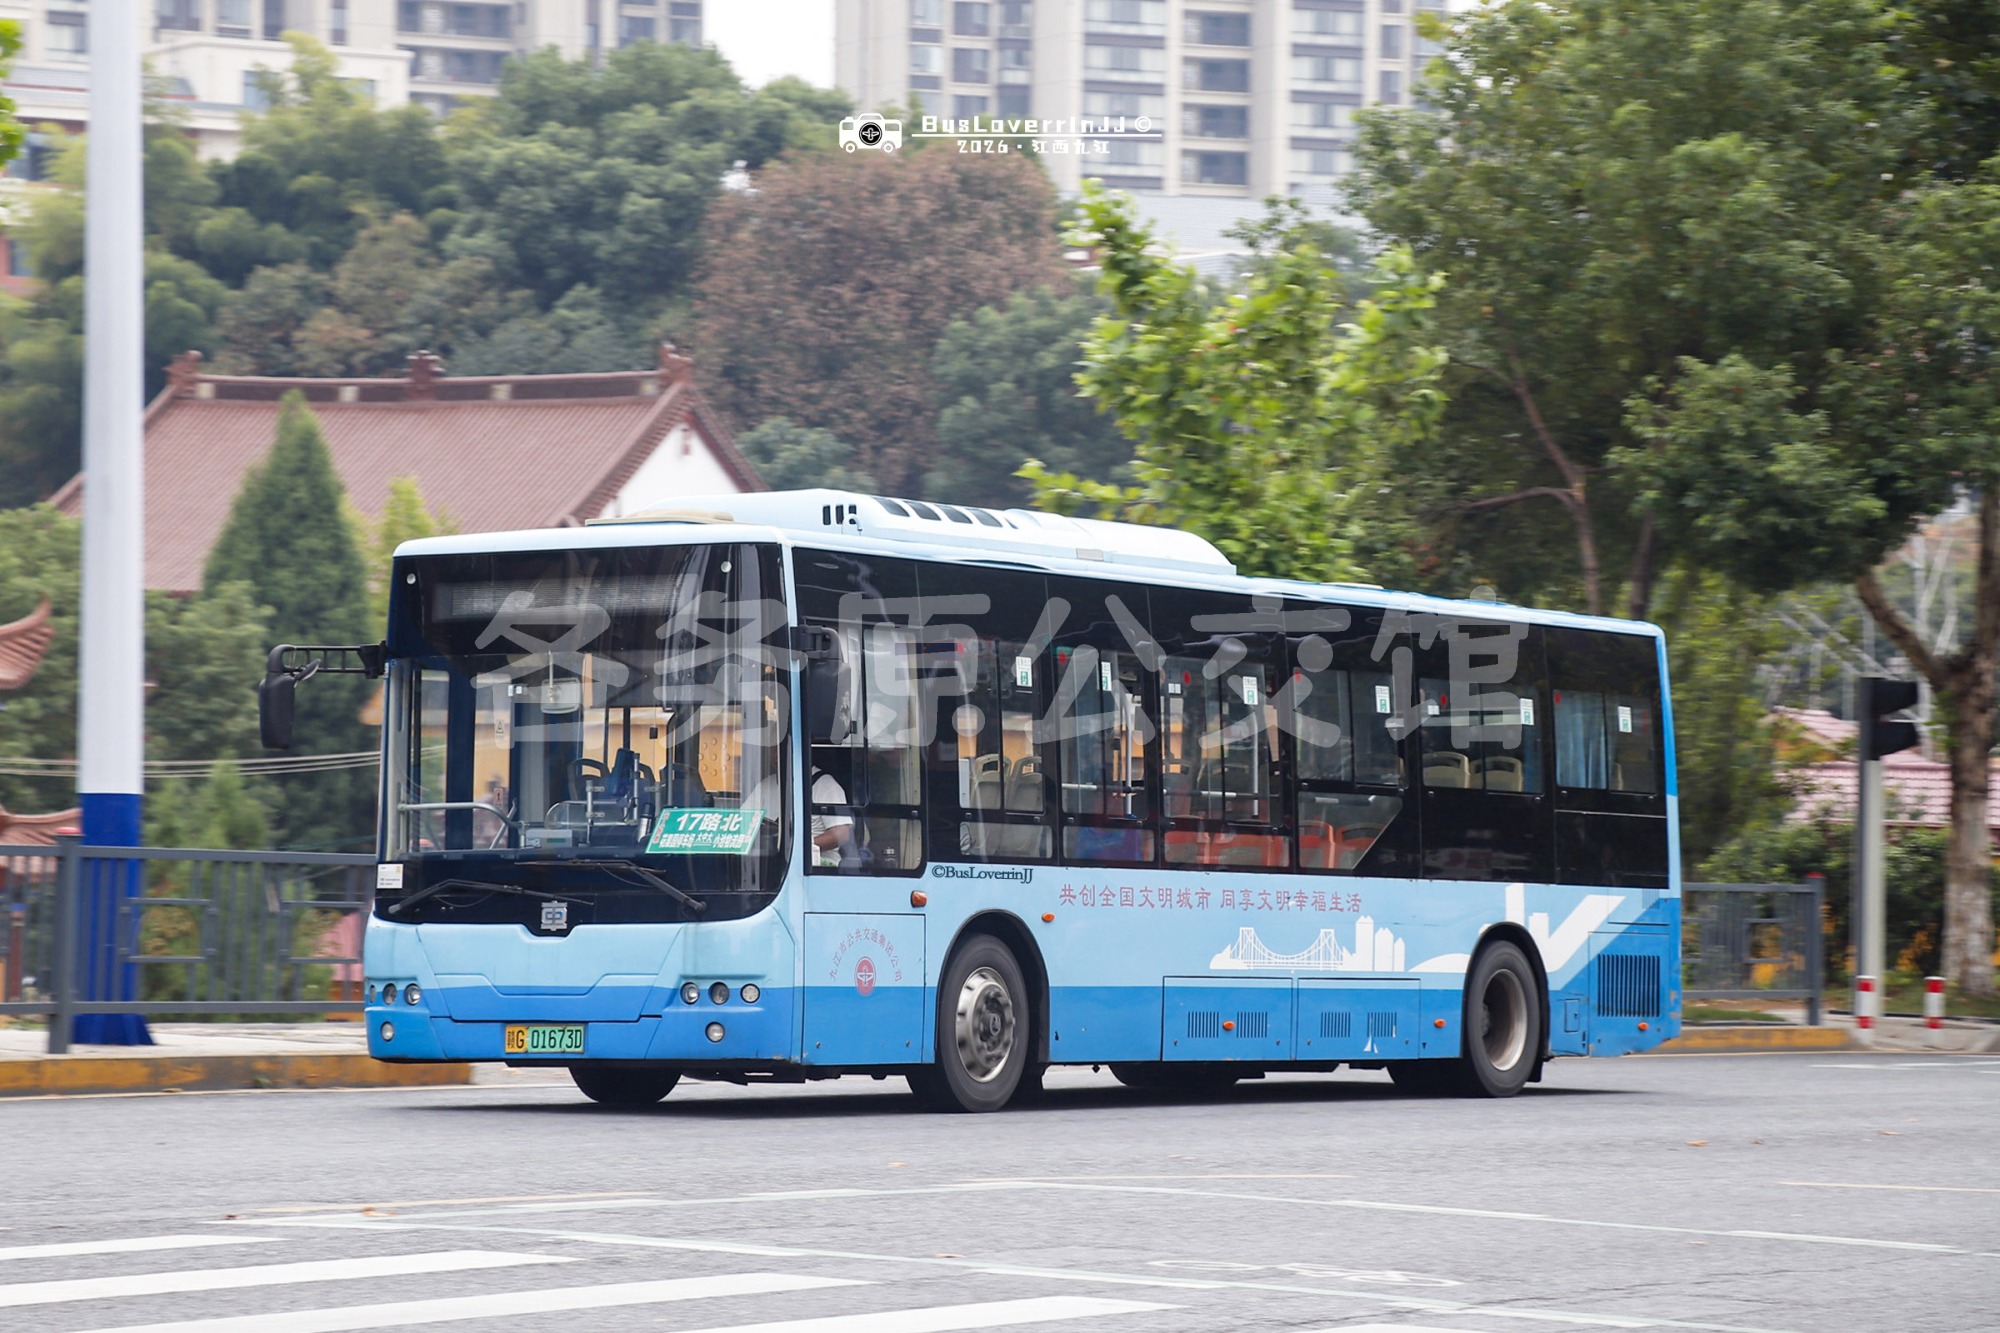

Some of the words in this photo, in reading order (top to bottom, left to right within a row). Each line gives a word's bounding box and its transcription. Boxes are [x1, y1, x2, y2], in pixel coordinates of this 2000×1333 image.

[676, 813, 743, 832] 17路北
[1059, 883, 1211, 910] 共创全国文明城市
[1220, 889, 1362, 913] 同享文明幸福生活
